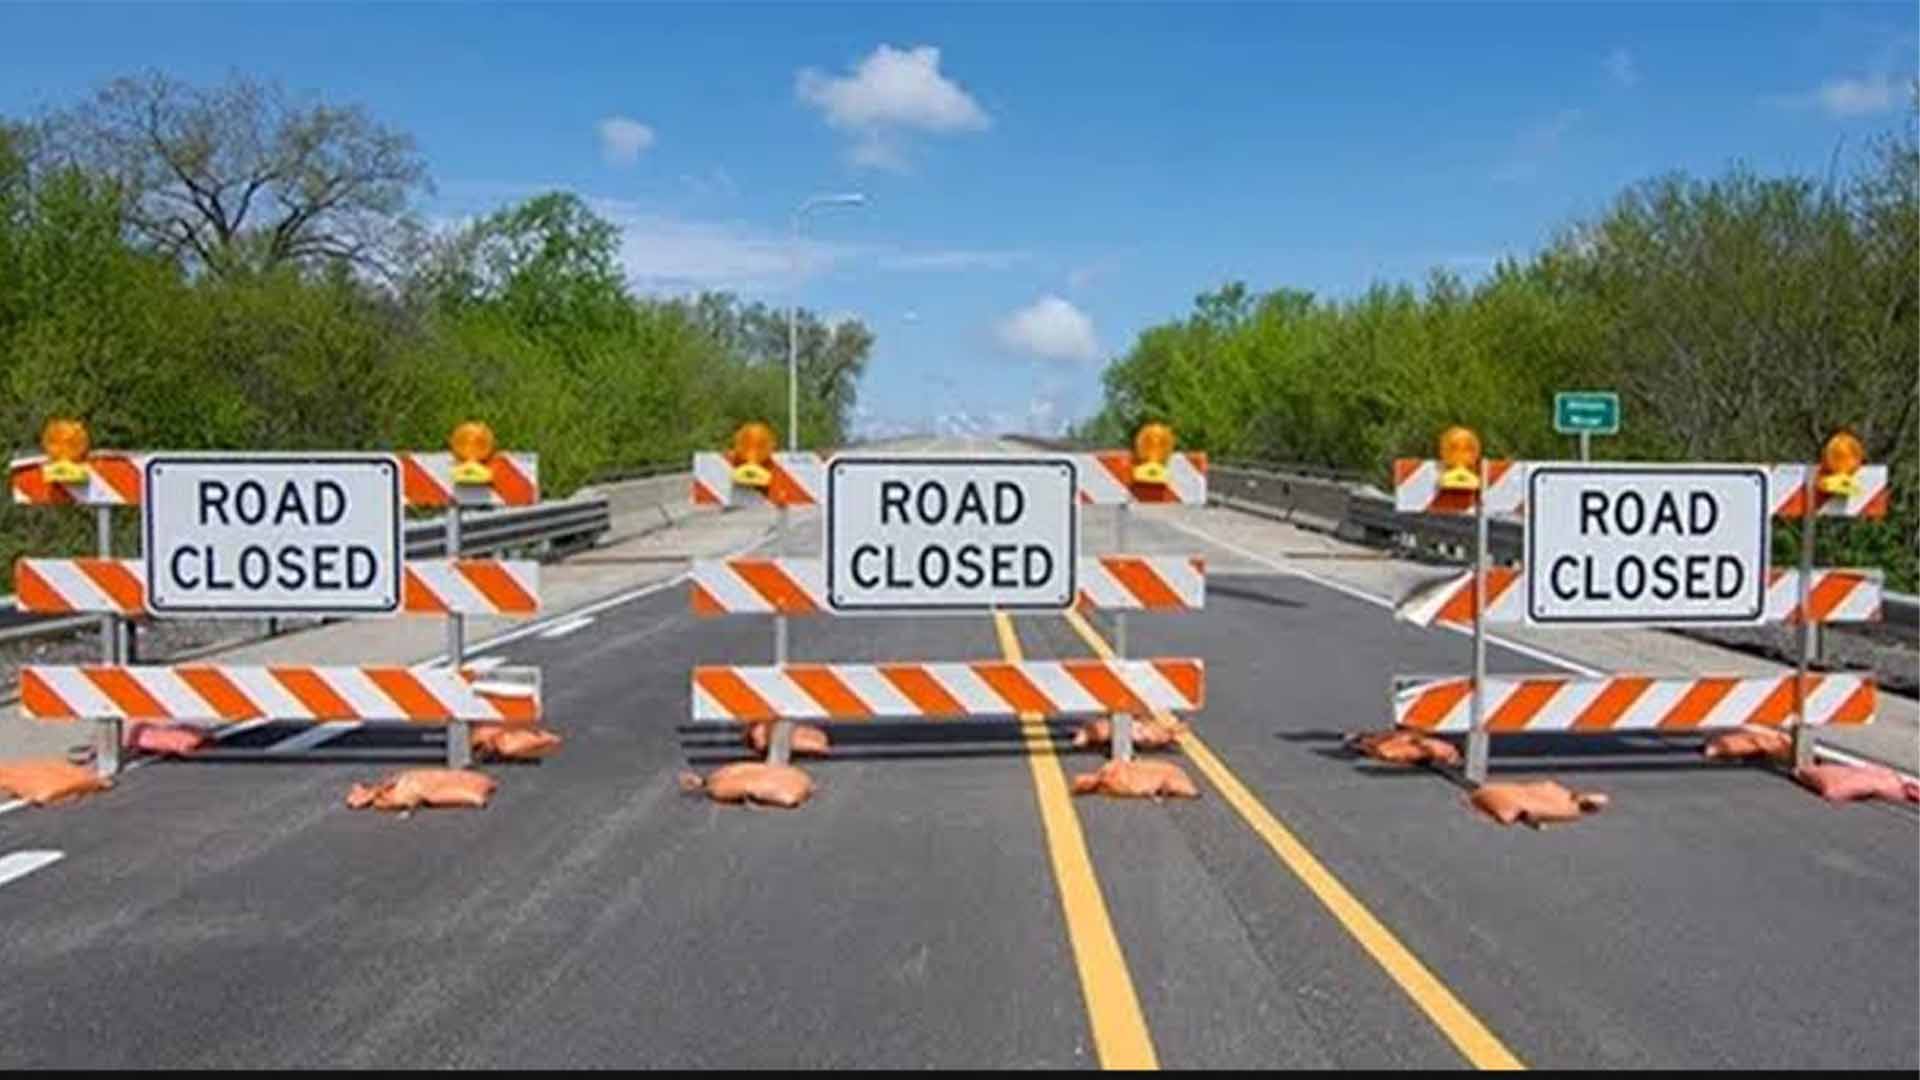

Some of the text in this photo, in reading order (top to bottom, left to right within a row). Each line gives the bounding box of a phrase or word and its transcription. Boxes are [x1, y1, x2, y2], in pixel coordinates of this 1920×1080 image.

[199, 480, 346, 526] ROAD
[881, 480, 1025, 526] ROAD
[1580, 490, 1718, 536] ROAD
[170, 544, 378, 591] CLOSED
[850, 544, 1054, 589] CLOSED
[1550, 554, 1745, 601] CLOSED
